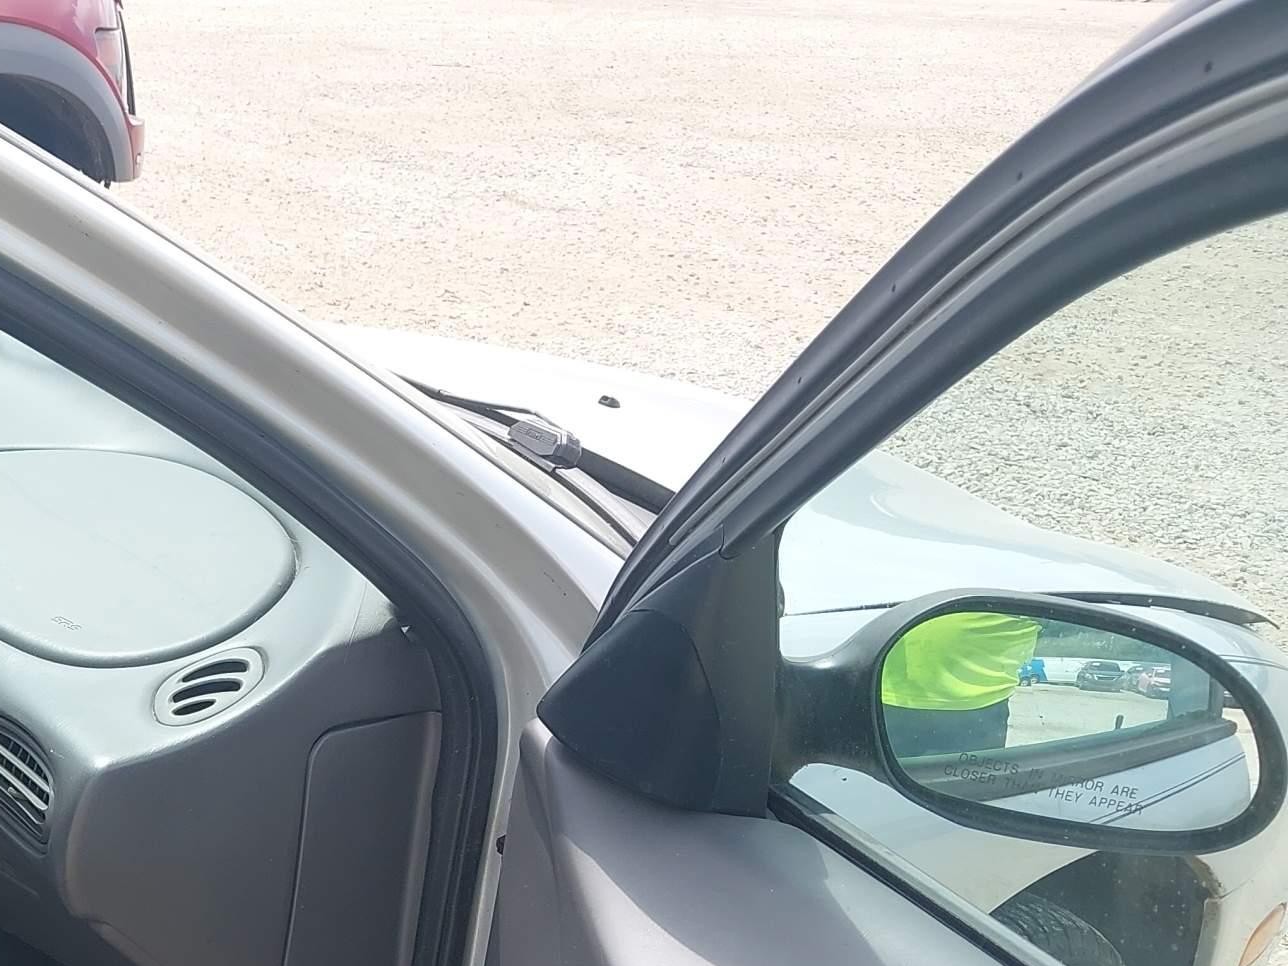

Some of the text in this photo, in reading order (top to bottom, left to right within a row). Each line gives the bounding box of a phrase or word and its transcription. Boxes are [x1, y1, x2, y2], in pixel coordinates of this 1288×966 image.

[943, 764, 997, 784] CLOSER
[1048, 786, 1083, 803] THEY
[1088, 795, 1144, 816] APPEAR
[958, 752, 1020, 776] OBJECTS
[1110, 784, 1139, 800] ARE
